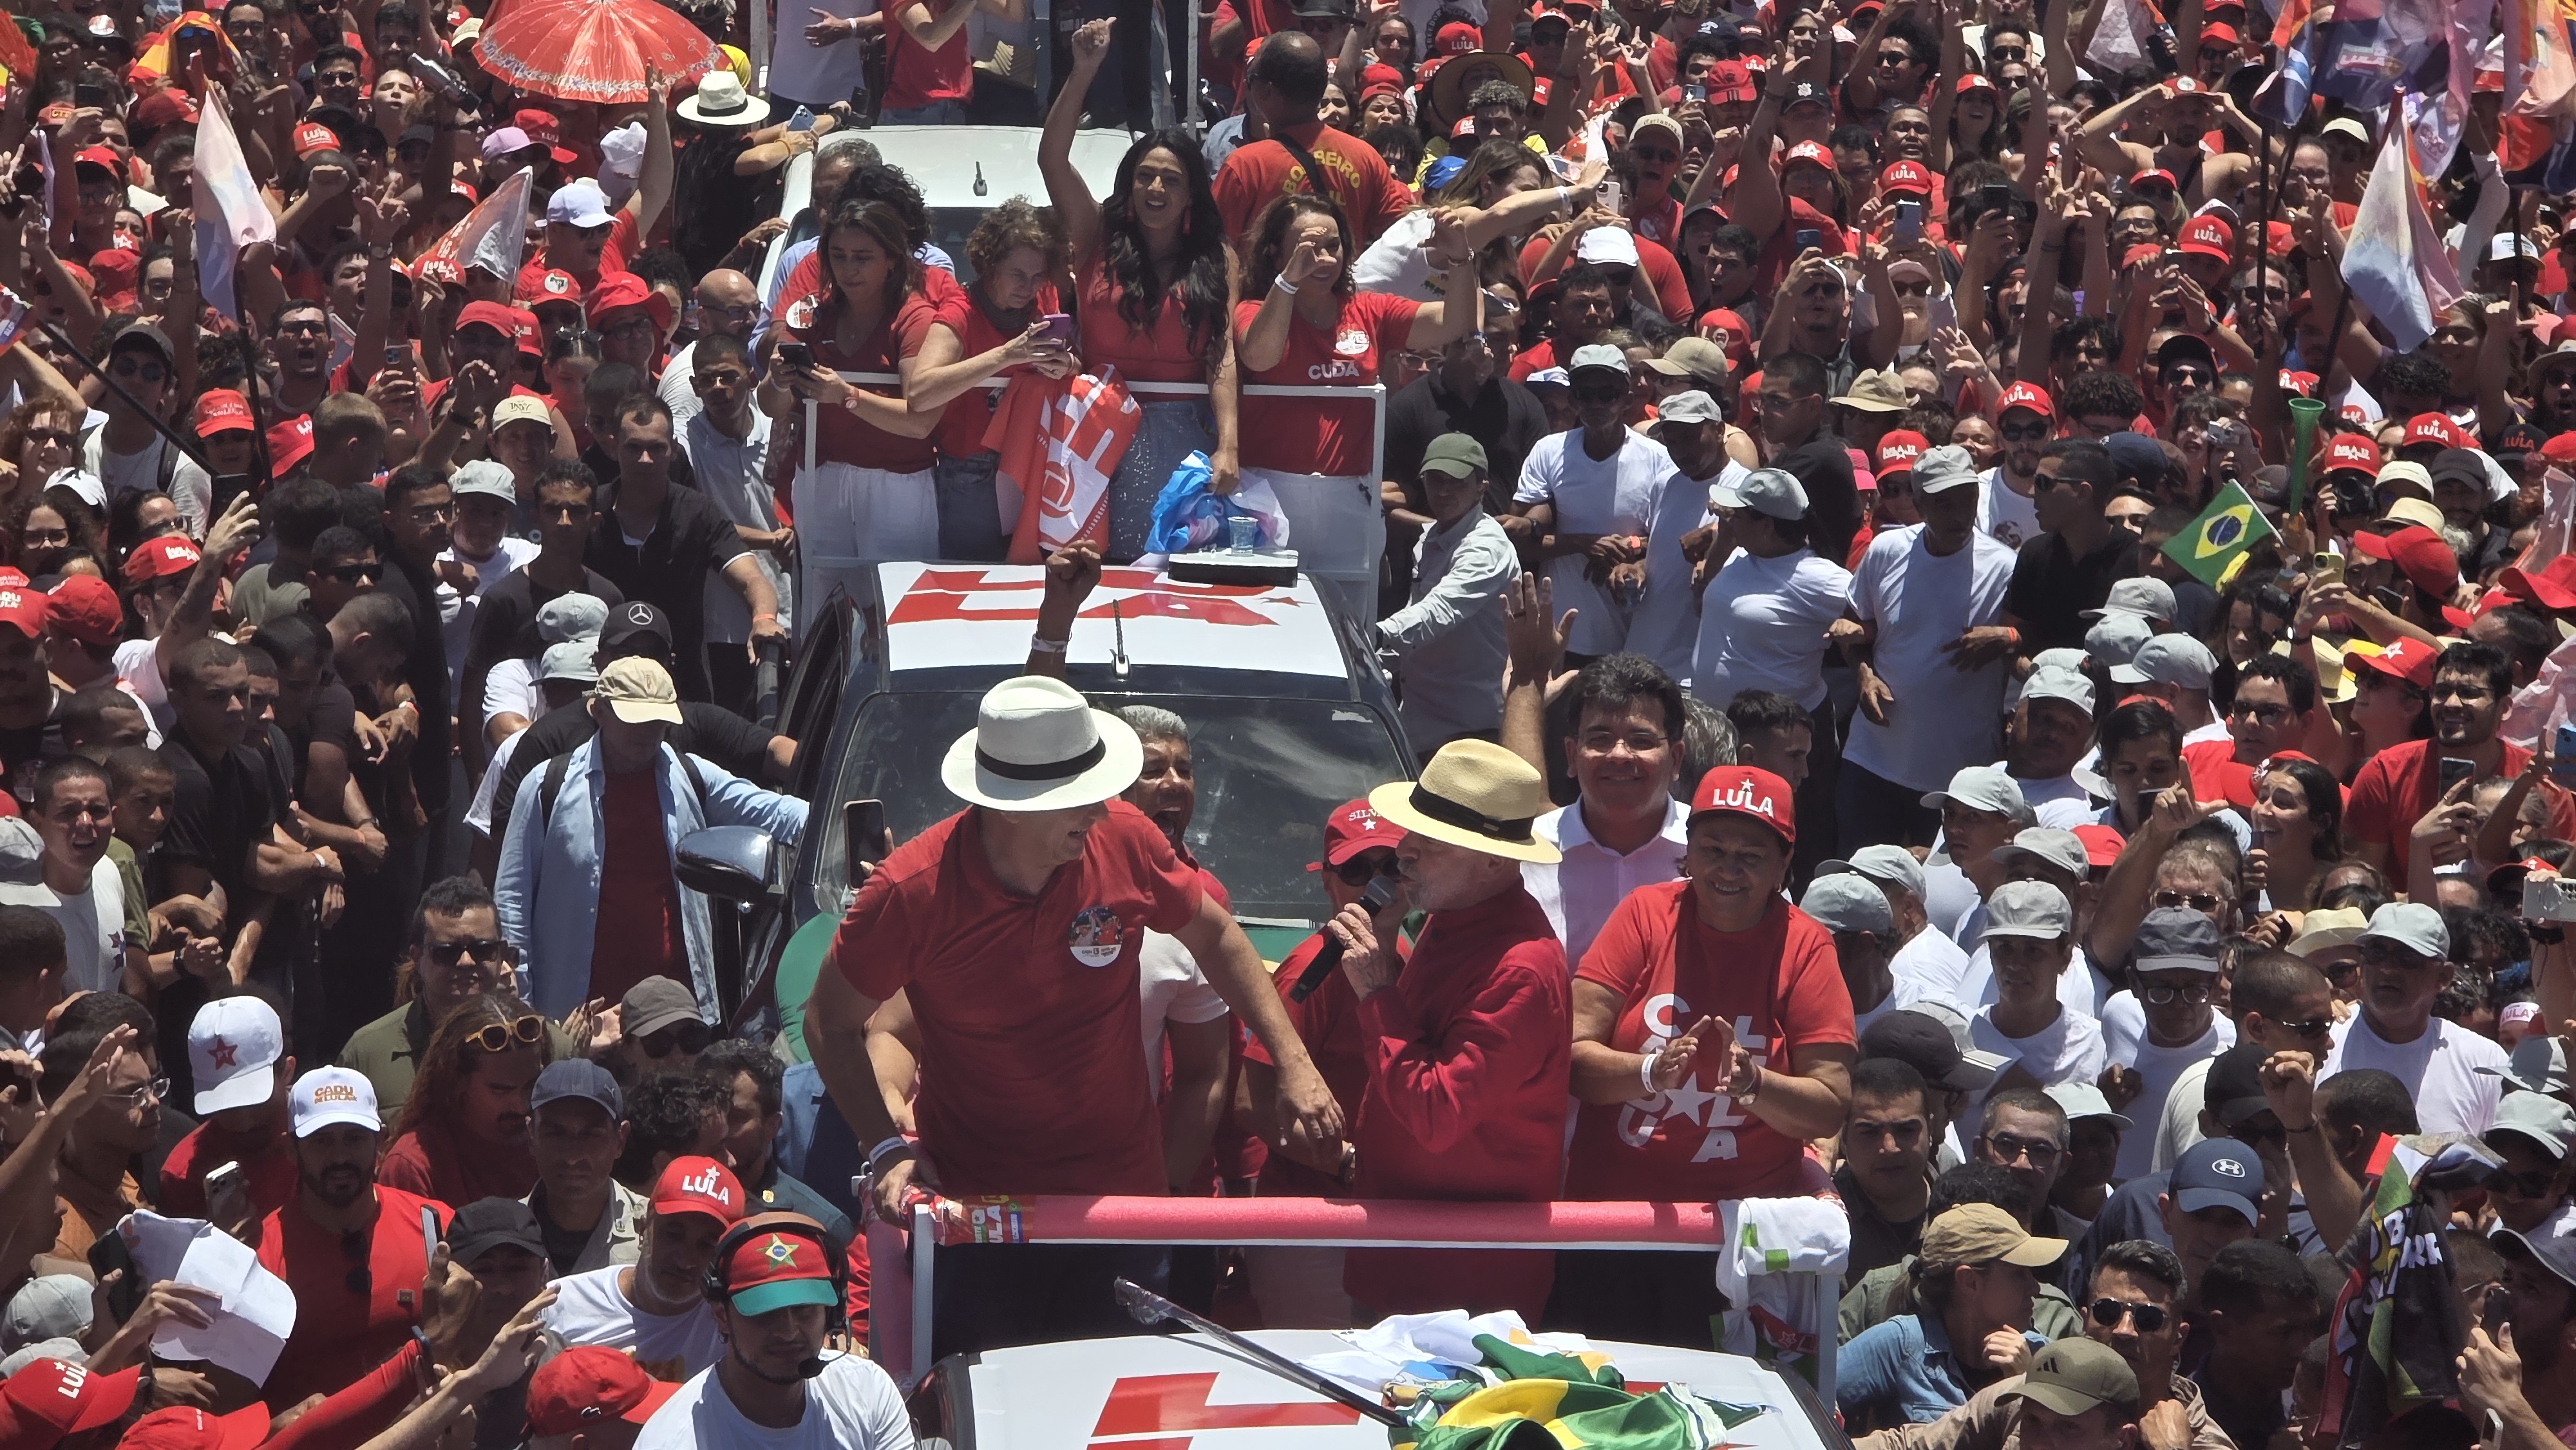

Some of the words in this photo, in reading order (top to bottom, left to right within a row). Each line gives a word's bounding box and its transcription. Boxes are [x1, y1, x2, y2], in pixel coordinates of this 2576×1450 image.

[1451, 41, 1474, 50] LULA
[1282, 150, 1361, 193] BOBEIRO
[1891, 171, 1917, 181] LULA
[2194, 229, 2222, 246] LULA
[1308, 361, 1360, 379] CUDA
[2004, 391, 2036, 406] LULA
[2417, 426, 2448, 441] LULA
[2505, 437, 2535, 450] LULA
[1713, 788, 1774, 818] LULA
[1349, 809, 1381, 821] SILV
[314, 1085, 354, 1097] CADU
[682, 1176, 729, 1206] LULA
[987, 1205, 1003, 1243] ULA
[58, 1364, 88, 1398] LUL
